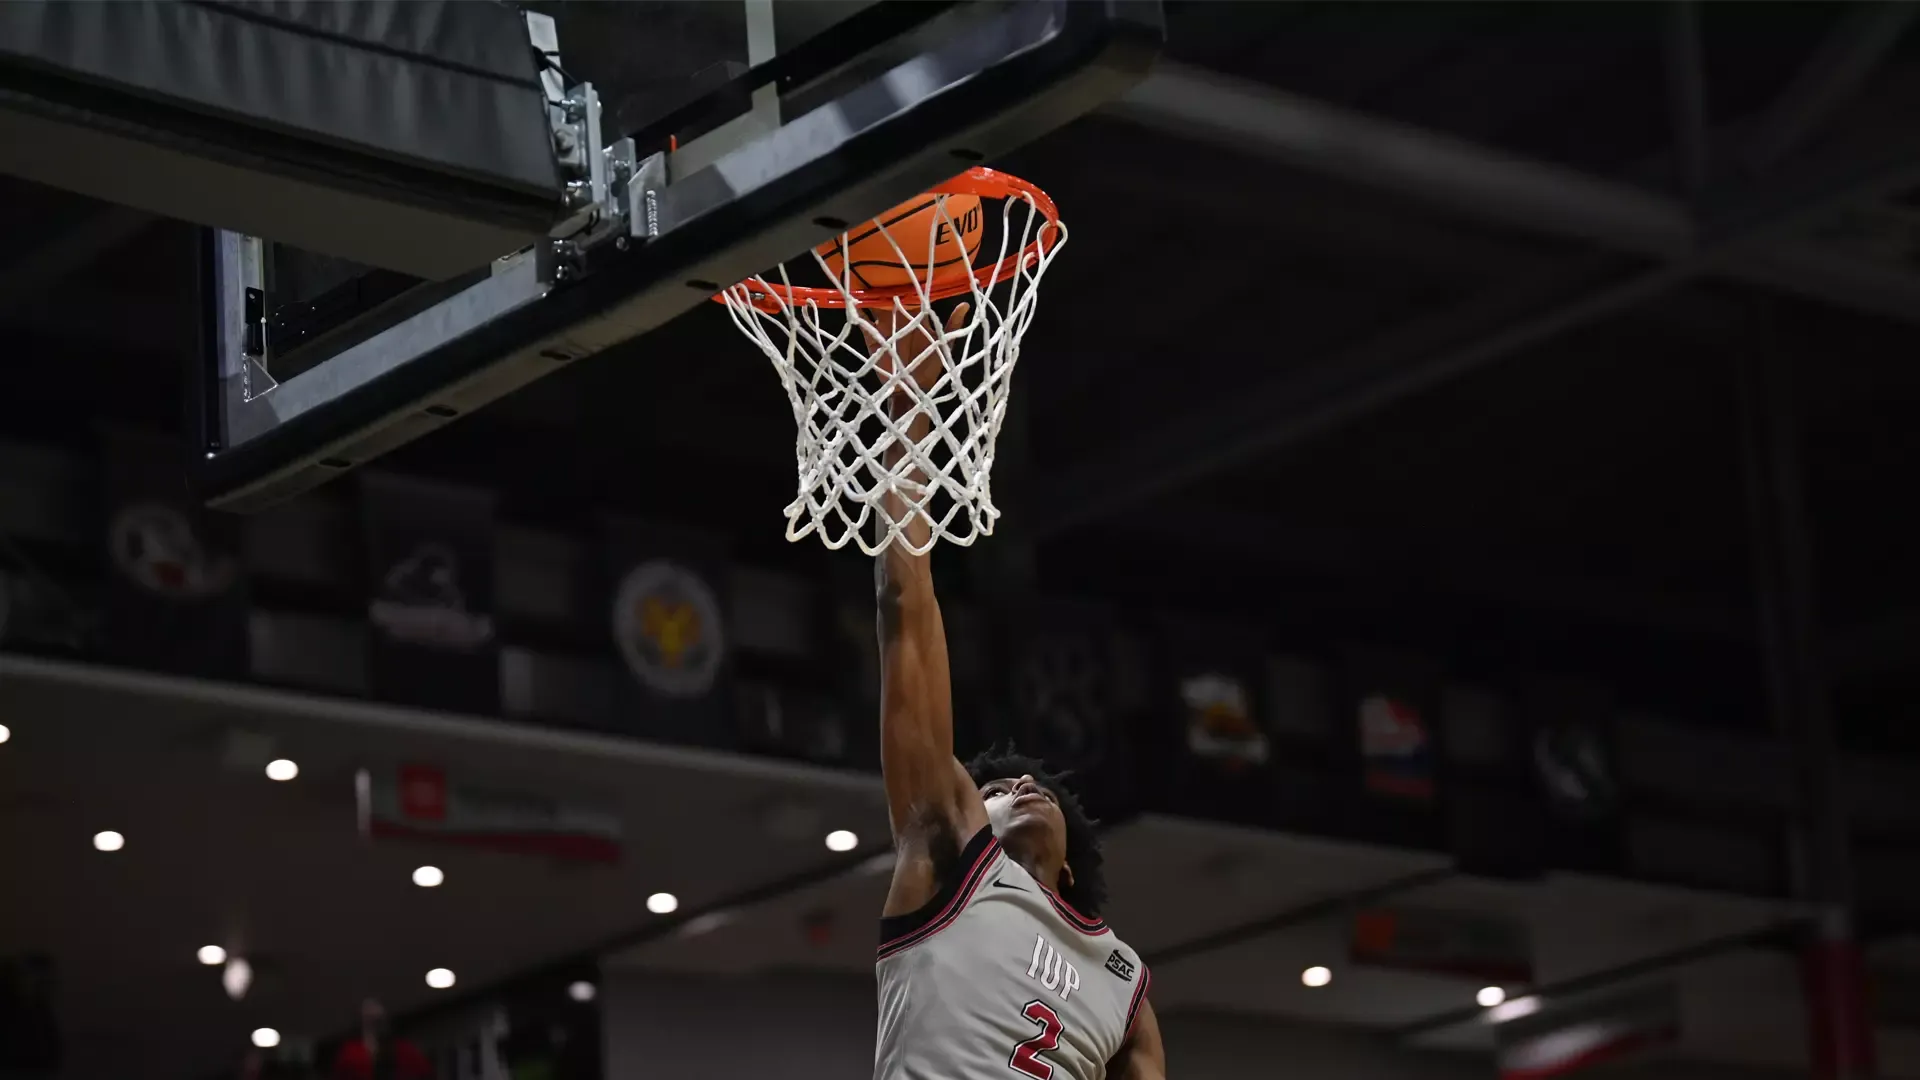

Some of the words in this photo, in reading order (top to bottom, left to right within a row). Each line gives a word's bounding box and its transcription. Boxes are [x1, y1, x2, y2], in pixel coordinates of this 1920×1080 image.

[936, 206, 977, 245] EVO
[1026, 933, 1080, 1001] IUP
[1107, 953, 1134, 978] PSAC
[1008, 999, 1065, 1080] 2
